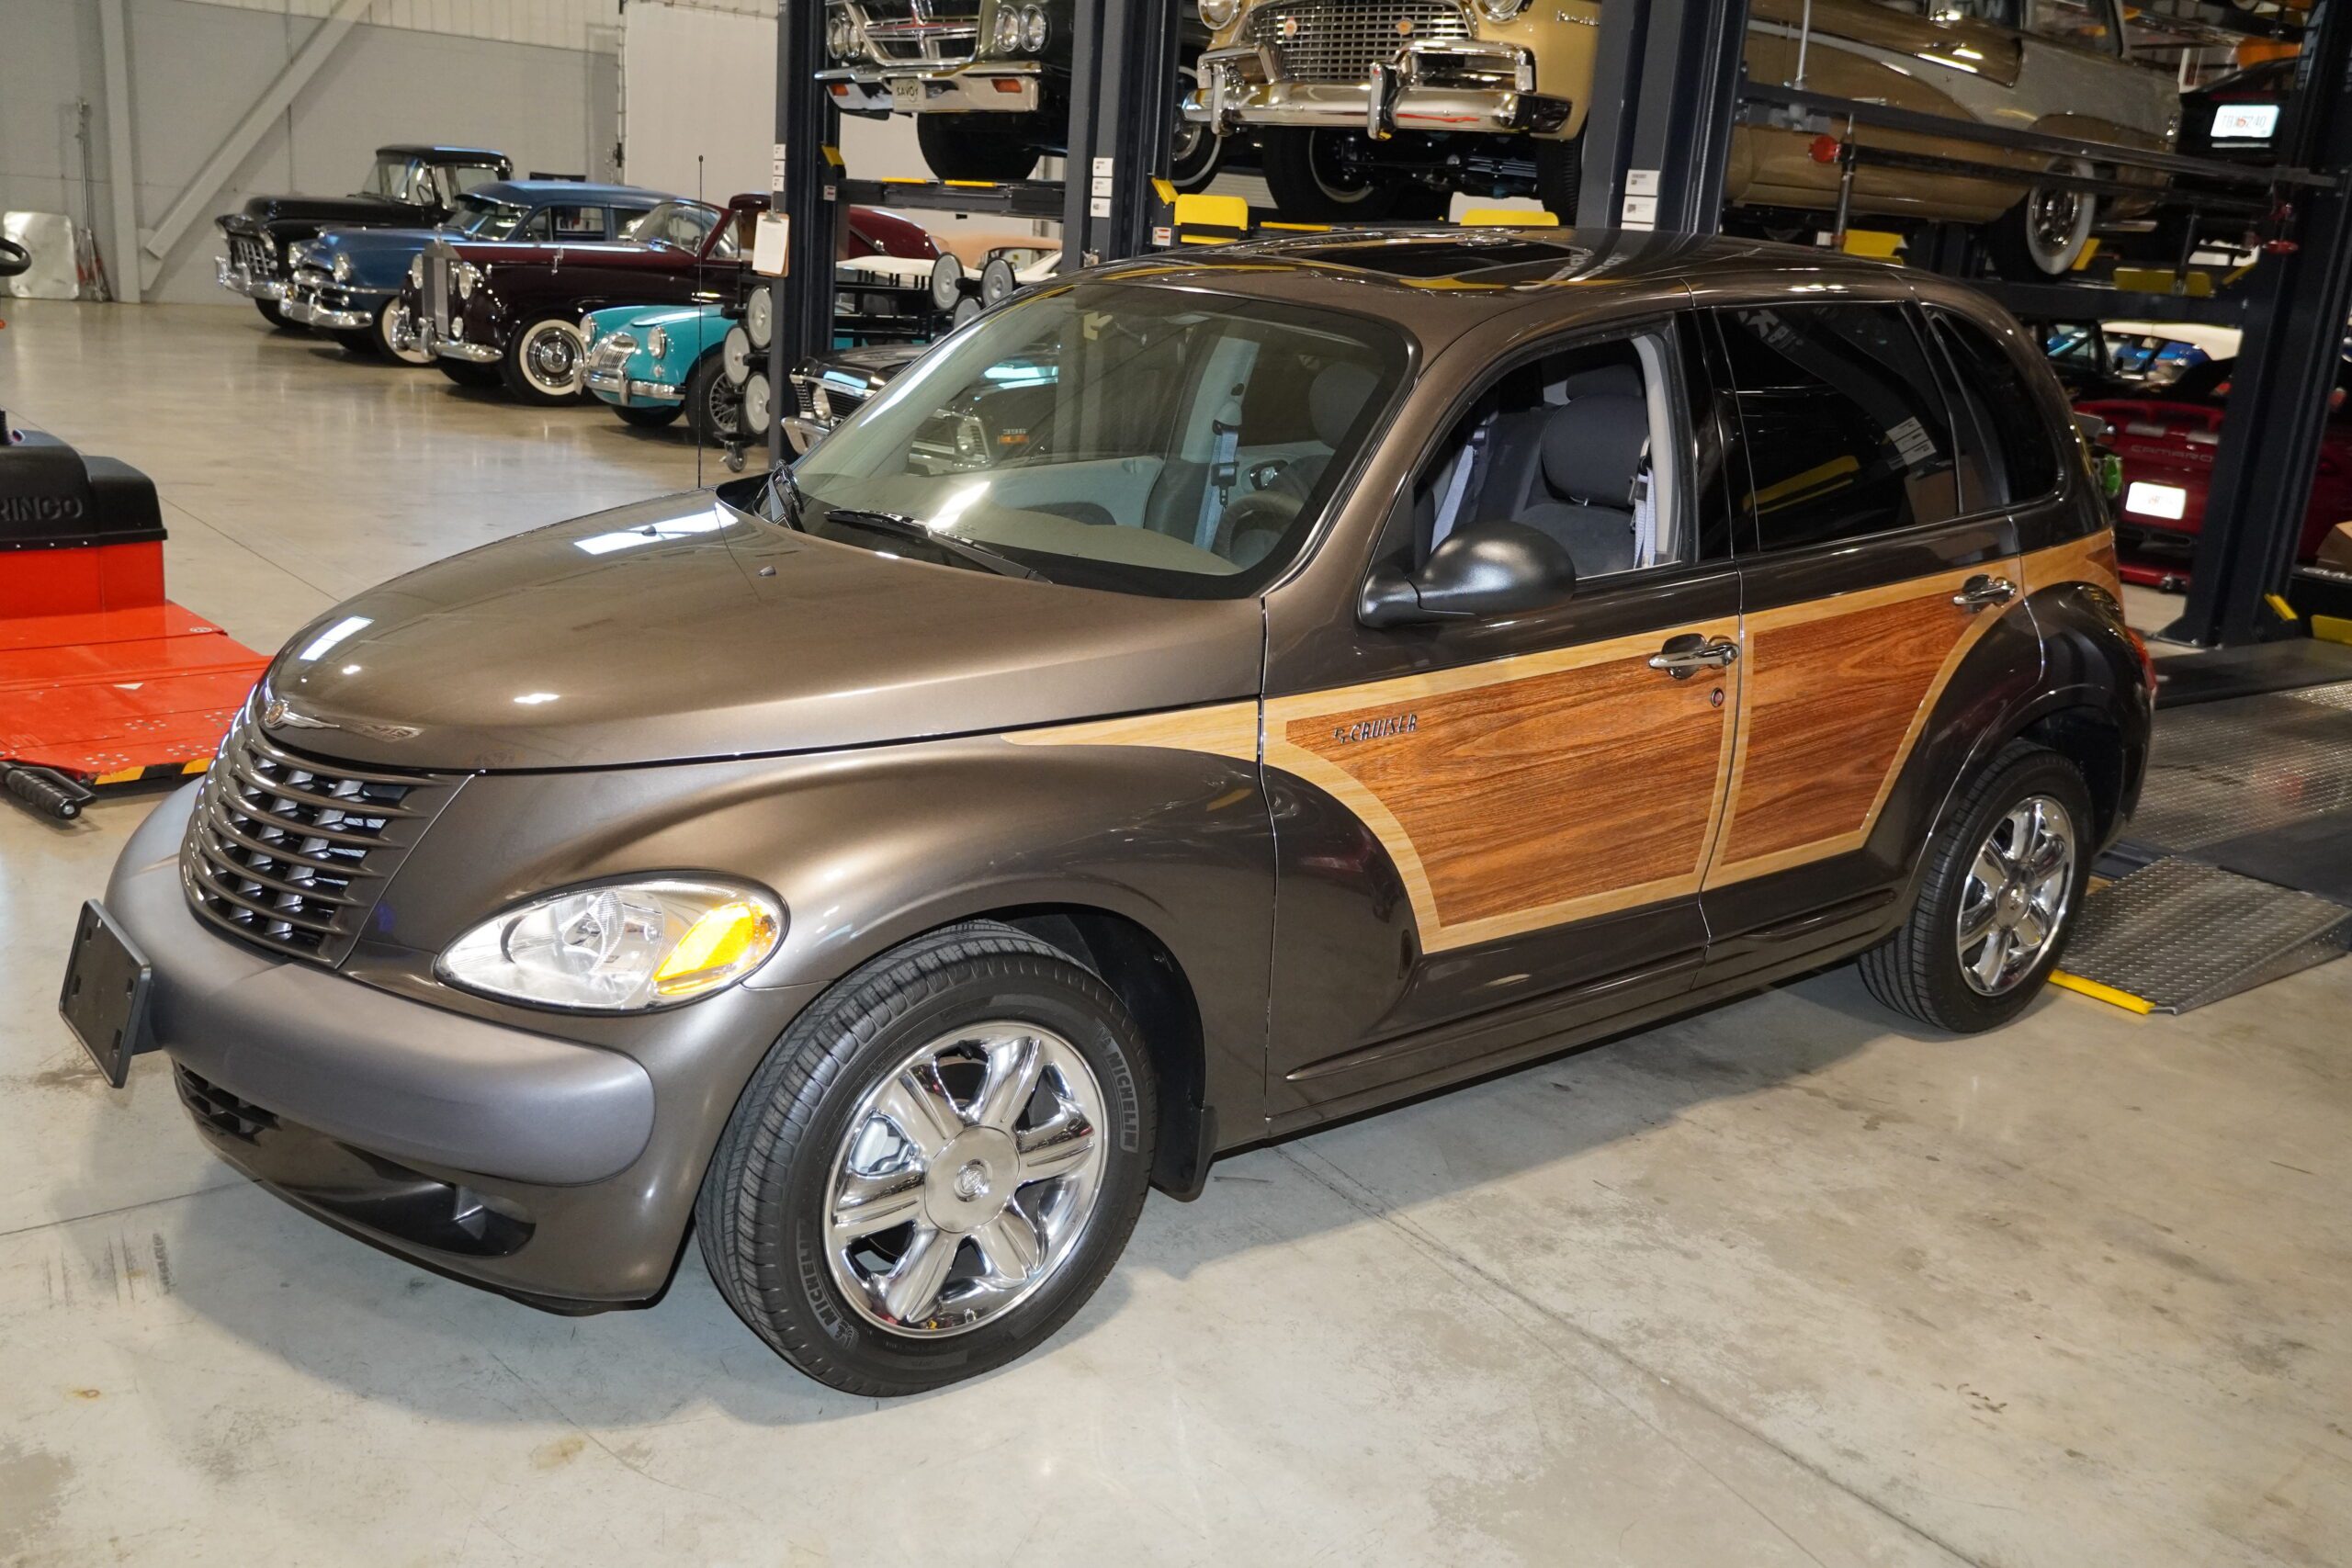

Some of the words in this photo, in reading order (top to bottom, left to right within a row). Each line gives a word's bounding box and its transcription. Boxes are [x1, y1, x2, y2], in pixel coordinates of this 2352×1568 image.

[896, 85, 919, 96] SAVOY
[2130, 445, 2214, 464] CAMARO
[1349, 713, 1418, 742] CRUISER
[1105, 1050, 1138, 1148] MICHELIN
[798, 1222, 840, 1327] MICHELI
